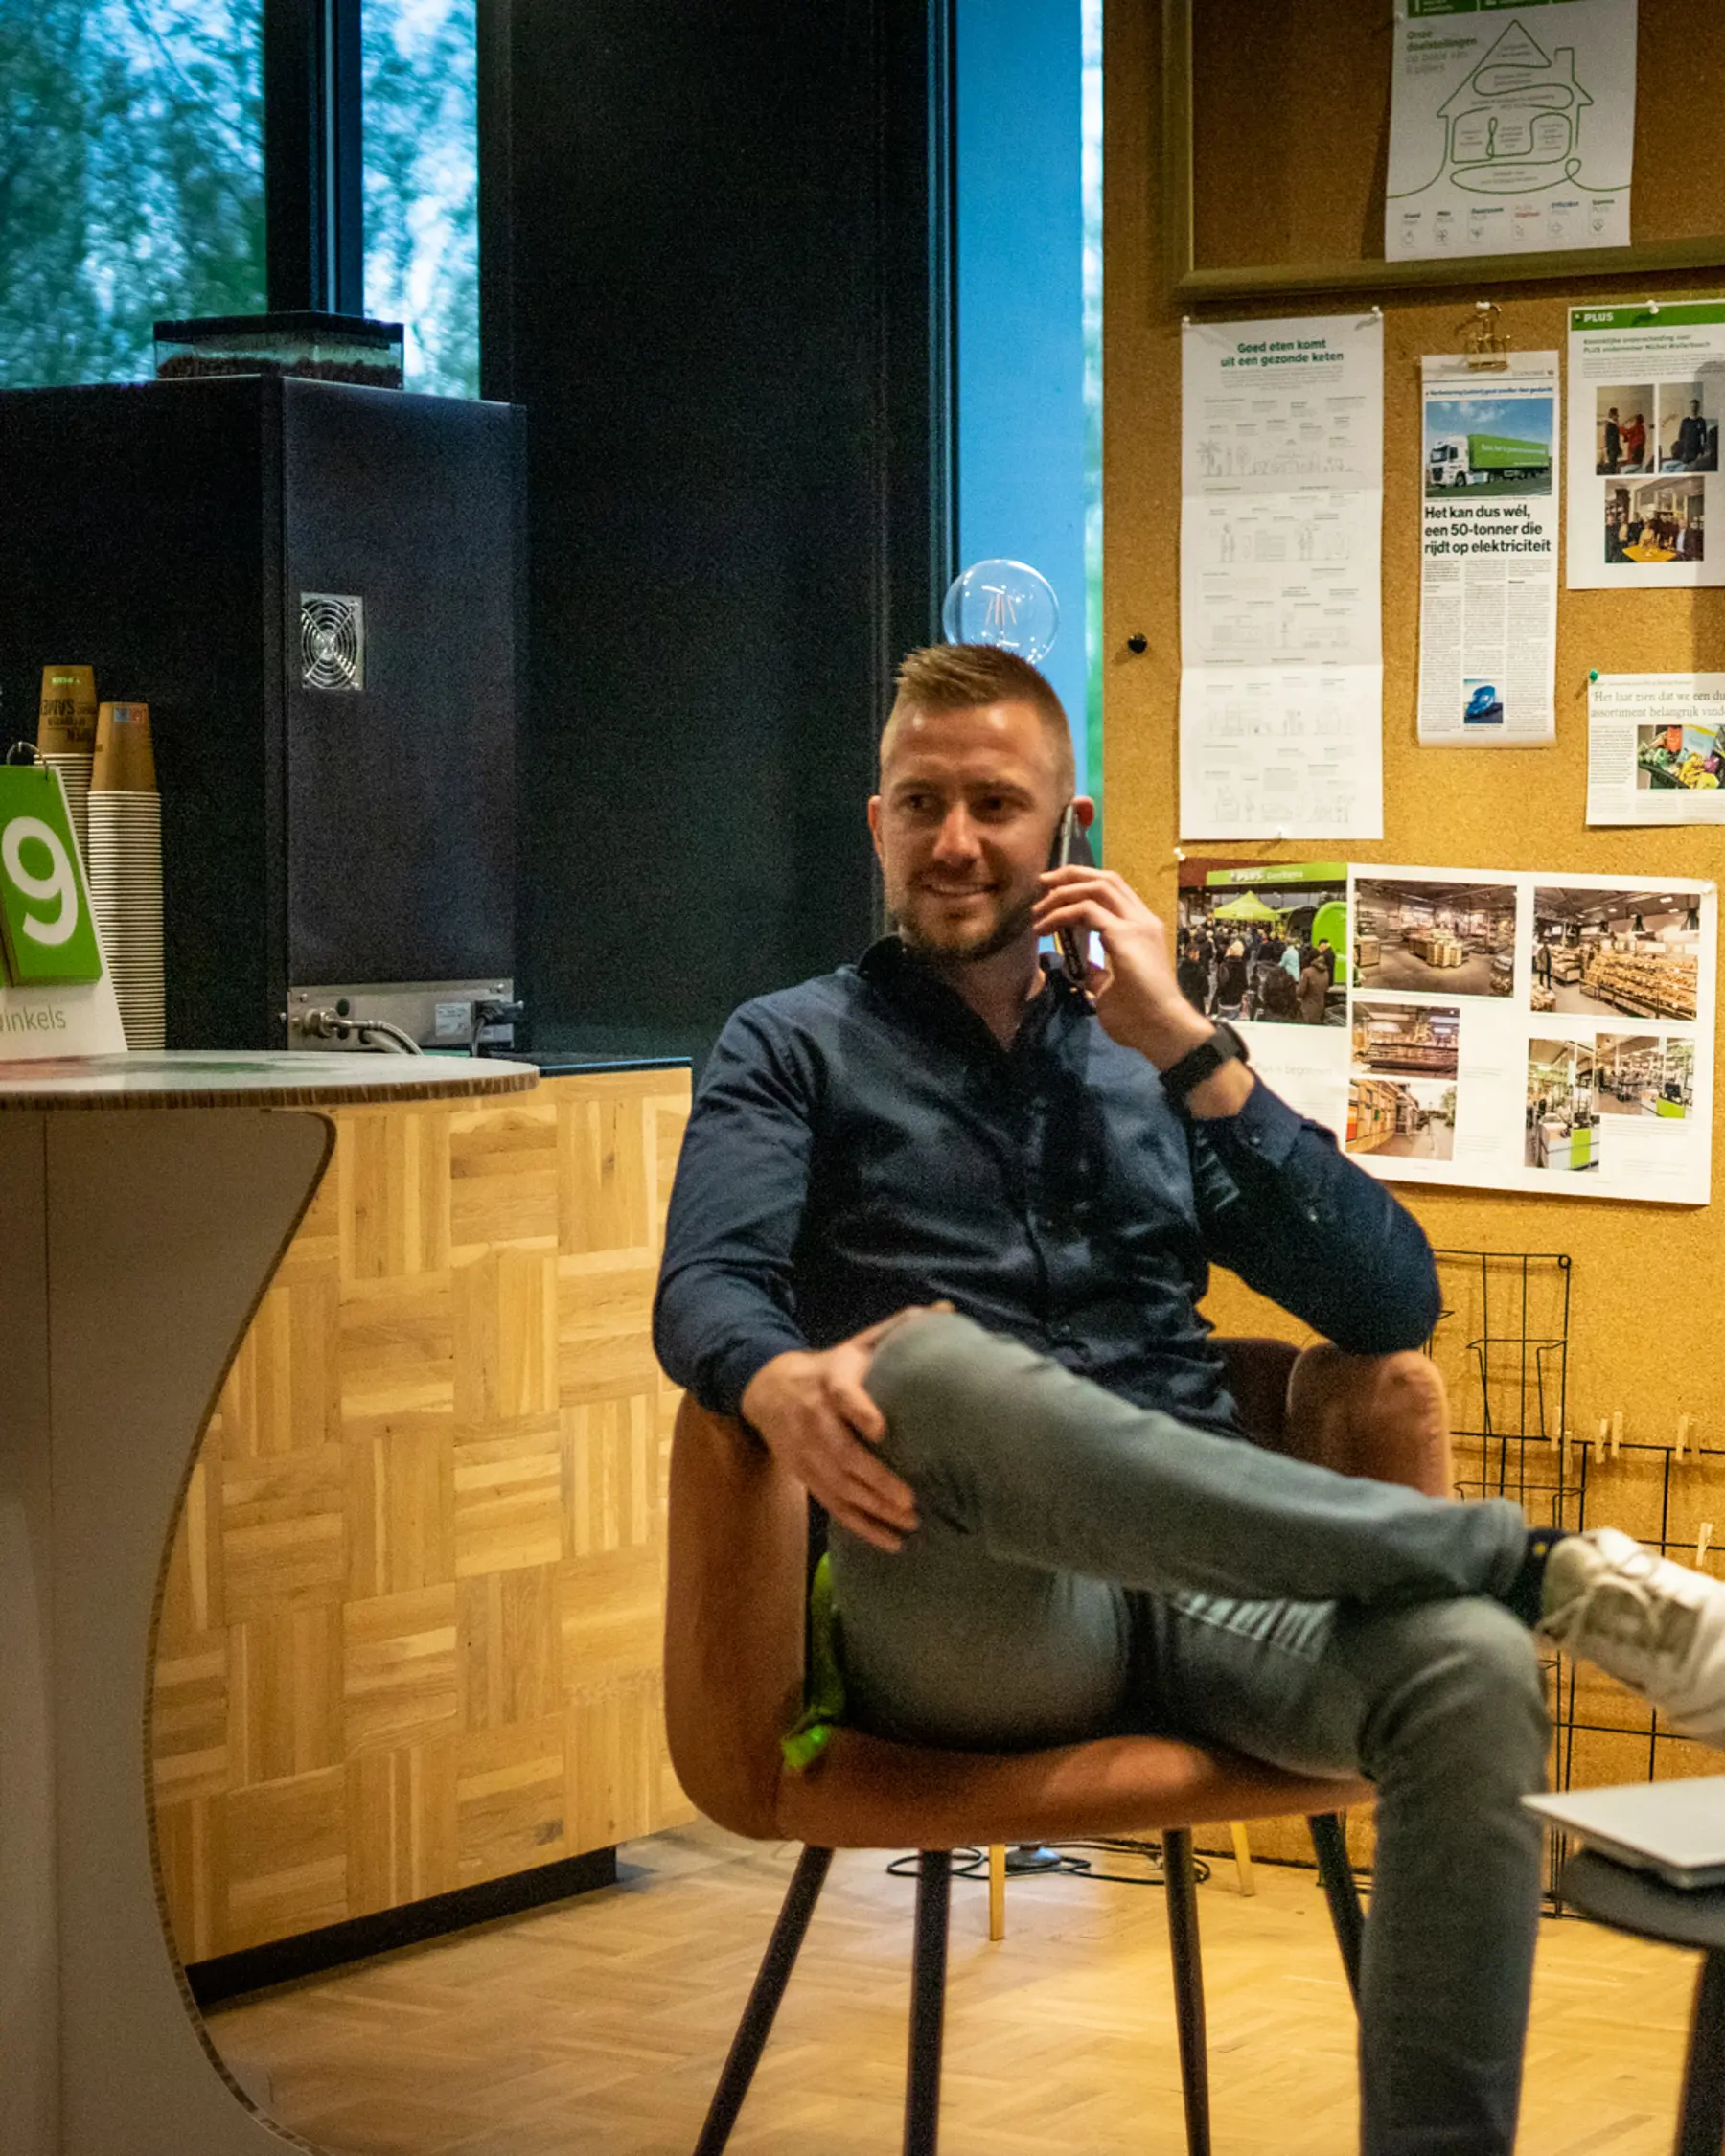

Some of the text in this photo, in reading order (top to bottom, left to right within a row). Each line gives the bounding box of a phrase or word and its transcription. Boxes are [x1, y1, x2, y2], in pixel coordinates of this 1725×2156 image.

[1583, 312, 1614, 323] PLUS
[1237, 339, 1326, 353] Goed eten komt
[1220, 351, 1344, 367] uit een gezonde keten
[1425, 503, 1531, 519] Het kan dus wél,
[1424, 520, 1543, 537] een 50-tonner die
[1424, 539, 1552, 557] rijdt op elektriciteit
[1615, 691, 1633, 702] laat
[1635, 692, 1656, 702] zien
[1658, 690, 1675, 702] dat
[1677, 693, 1690, 701] we
[1692, 692, 1711, 701] een
[1590, 707, 1646, 719] assortiment
[1649, 705, 1699, 721] belangrijk
[1, 815, 79, 946] 9
[0, 1004, 66, 1032] inkels
